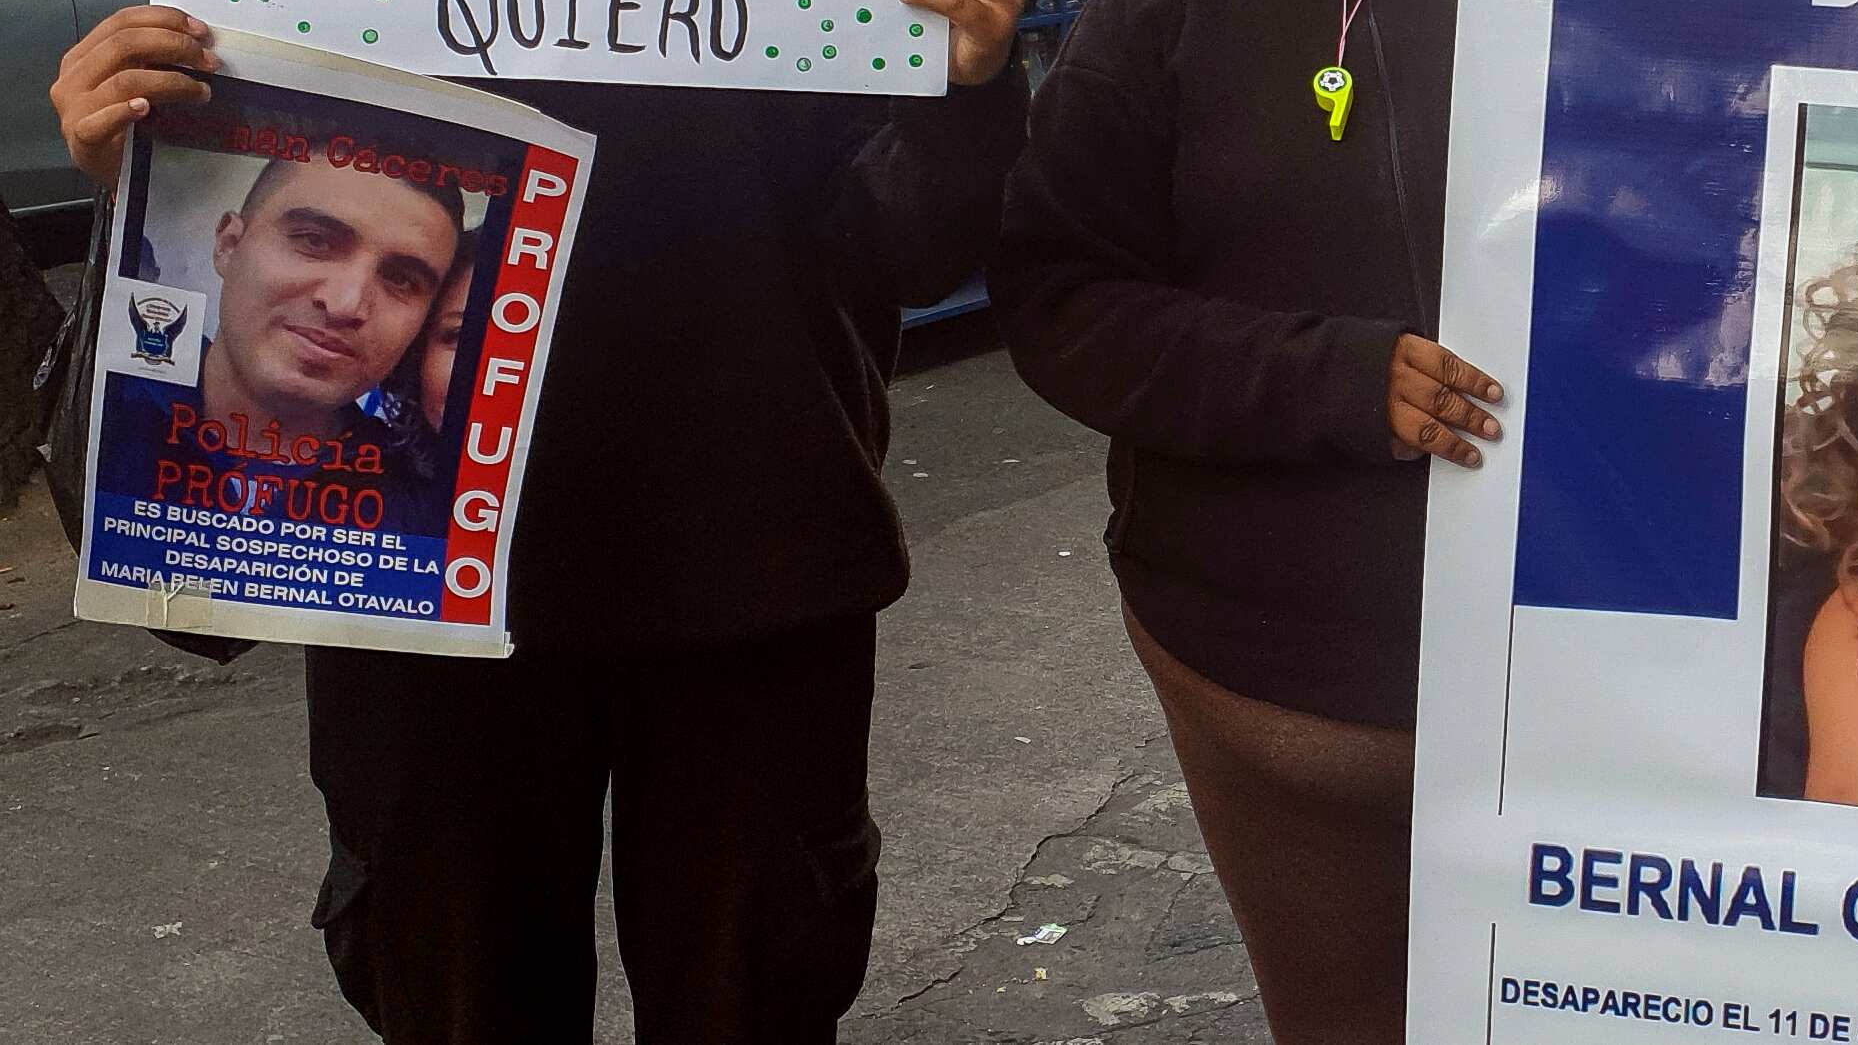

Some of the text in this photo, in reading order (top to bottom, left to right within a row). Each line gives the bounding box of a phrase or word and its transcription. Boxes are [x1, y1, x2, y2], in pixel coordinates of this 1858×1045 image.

[445, 169, 568, 598] PROFUGO
[167, 403, 384, 475] Policía
[134, 500, 407, 551] ES BUSCADO POR SER EL
[152, 459, 385, 530] PRÓFUGO
[104, 516, 439, 575] PRINCIPAL SOSPECHOSO DE LA
[165, 549, 364, 587] DESAPARICIÓN DE
[101, 560, 435, 616] MARIA BELEN BERNAL OTAVALO
[1529, 843, 1820, 936] BERNAL
[1500, 977, 1713, 1026] DESAPARECIO
[1723, 1003, 1761, 1032] EL
[1768, 1008, 1798, 1036] 11
[1809, 1012, 1850, 1042] DE
